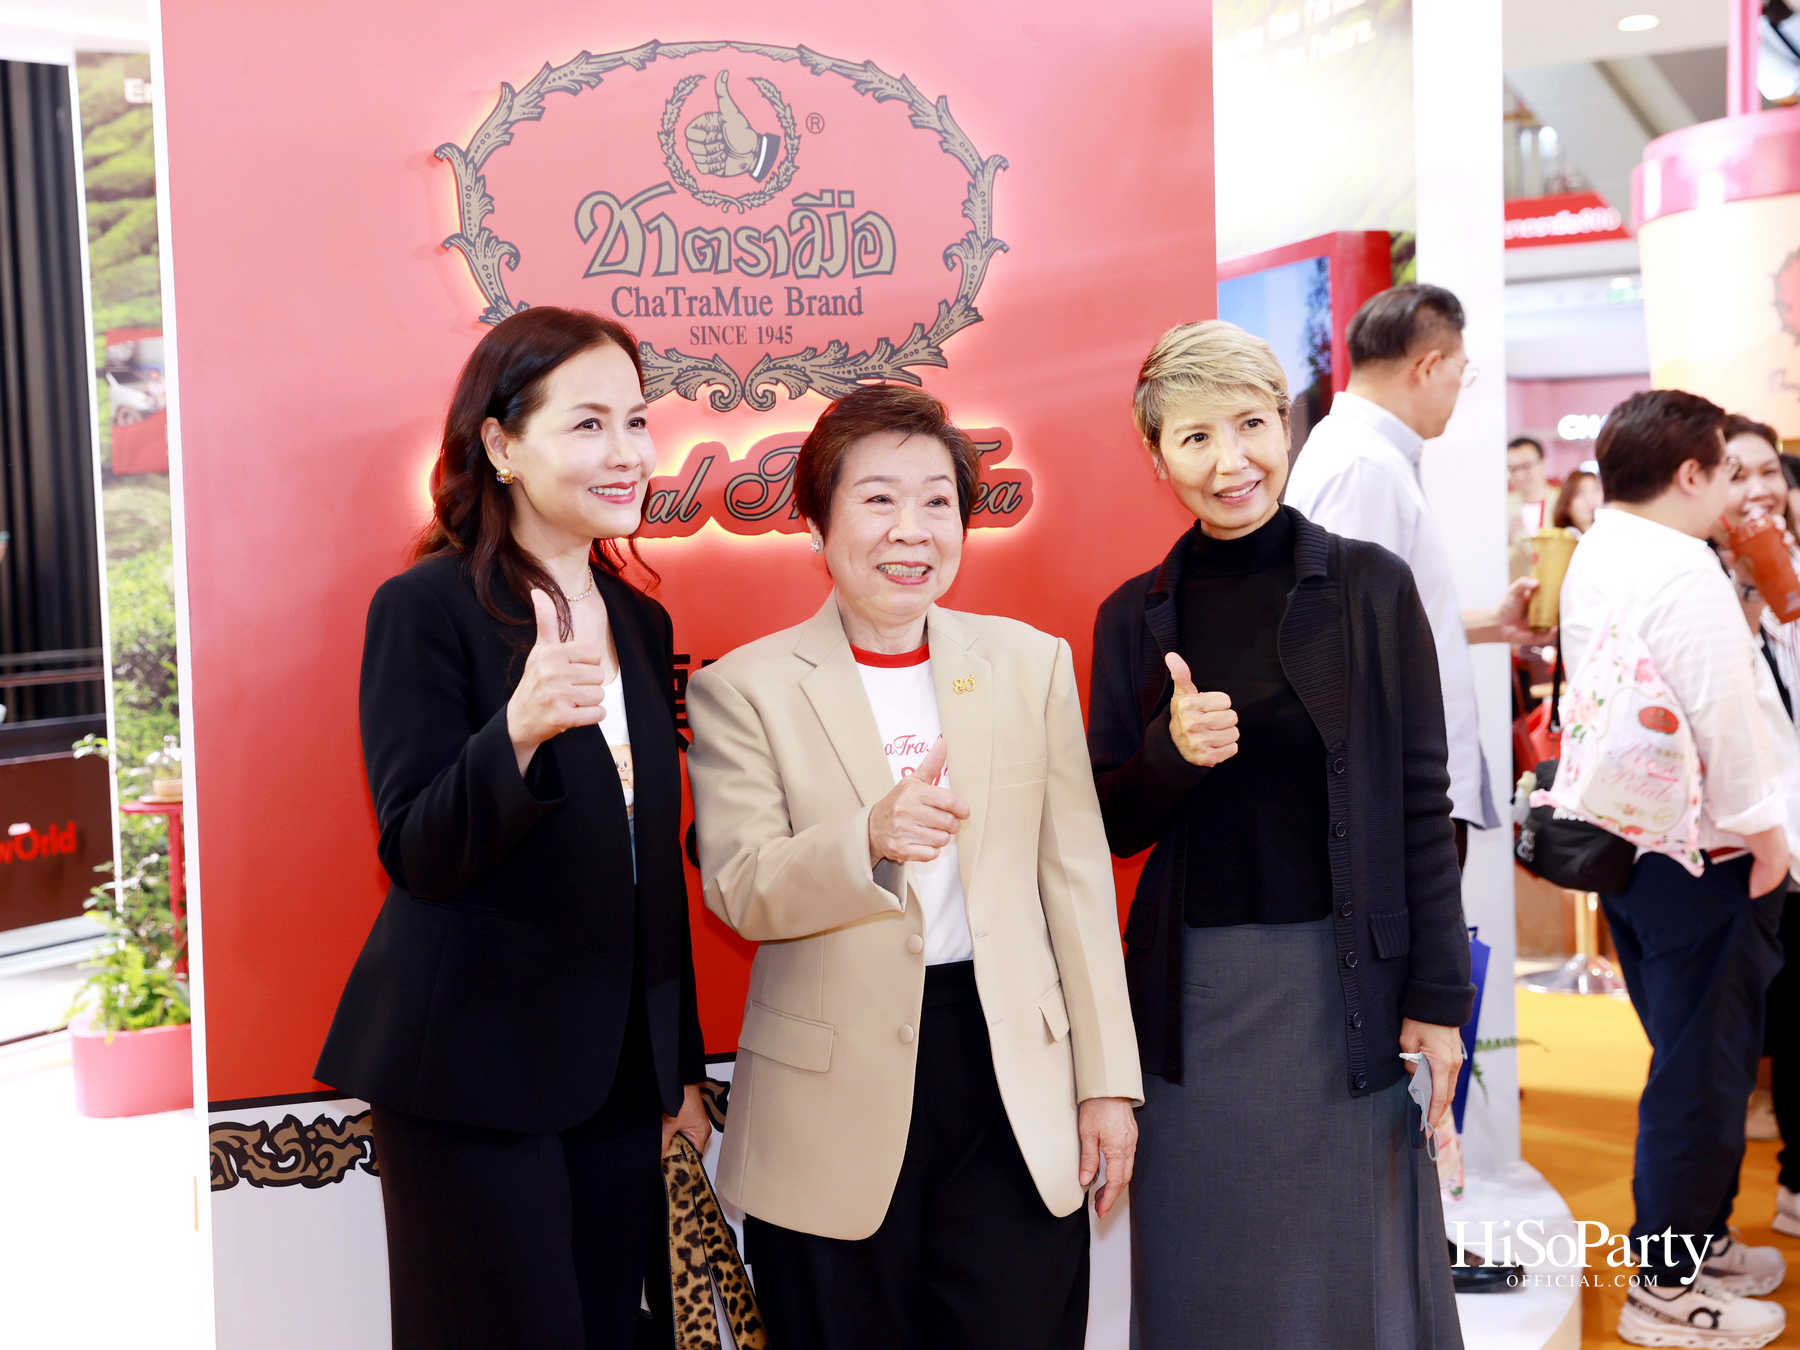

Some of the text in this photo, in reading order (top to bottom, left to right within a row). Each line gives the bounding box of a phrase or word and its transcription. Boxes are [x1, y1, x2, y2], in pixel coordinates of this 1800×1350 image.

[574, 180, 896, 280] ชาตรามือ
[611, 285, 865, 318] ChaTraMue Brand
[689, 325, 794, 346] SINCE 1945
[645, 455, 702, 524] al
[884, 733, 943, 757] aTra
